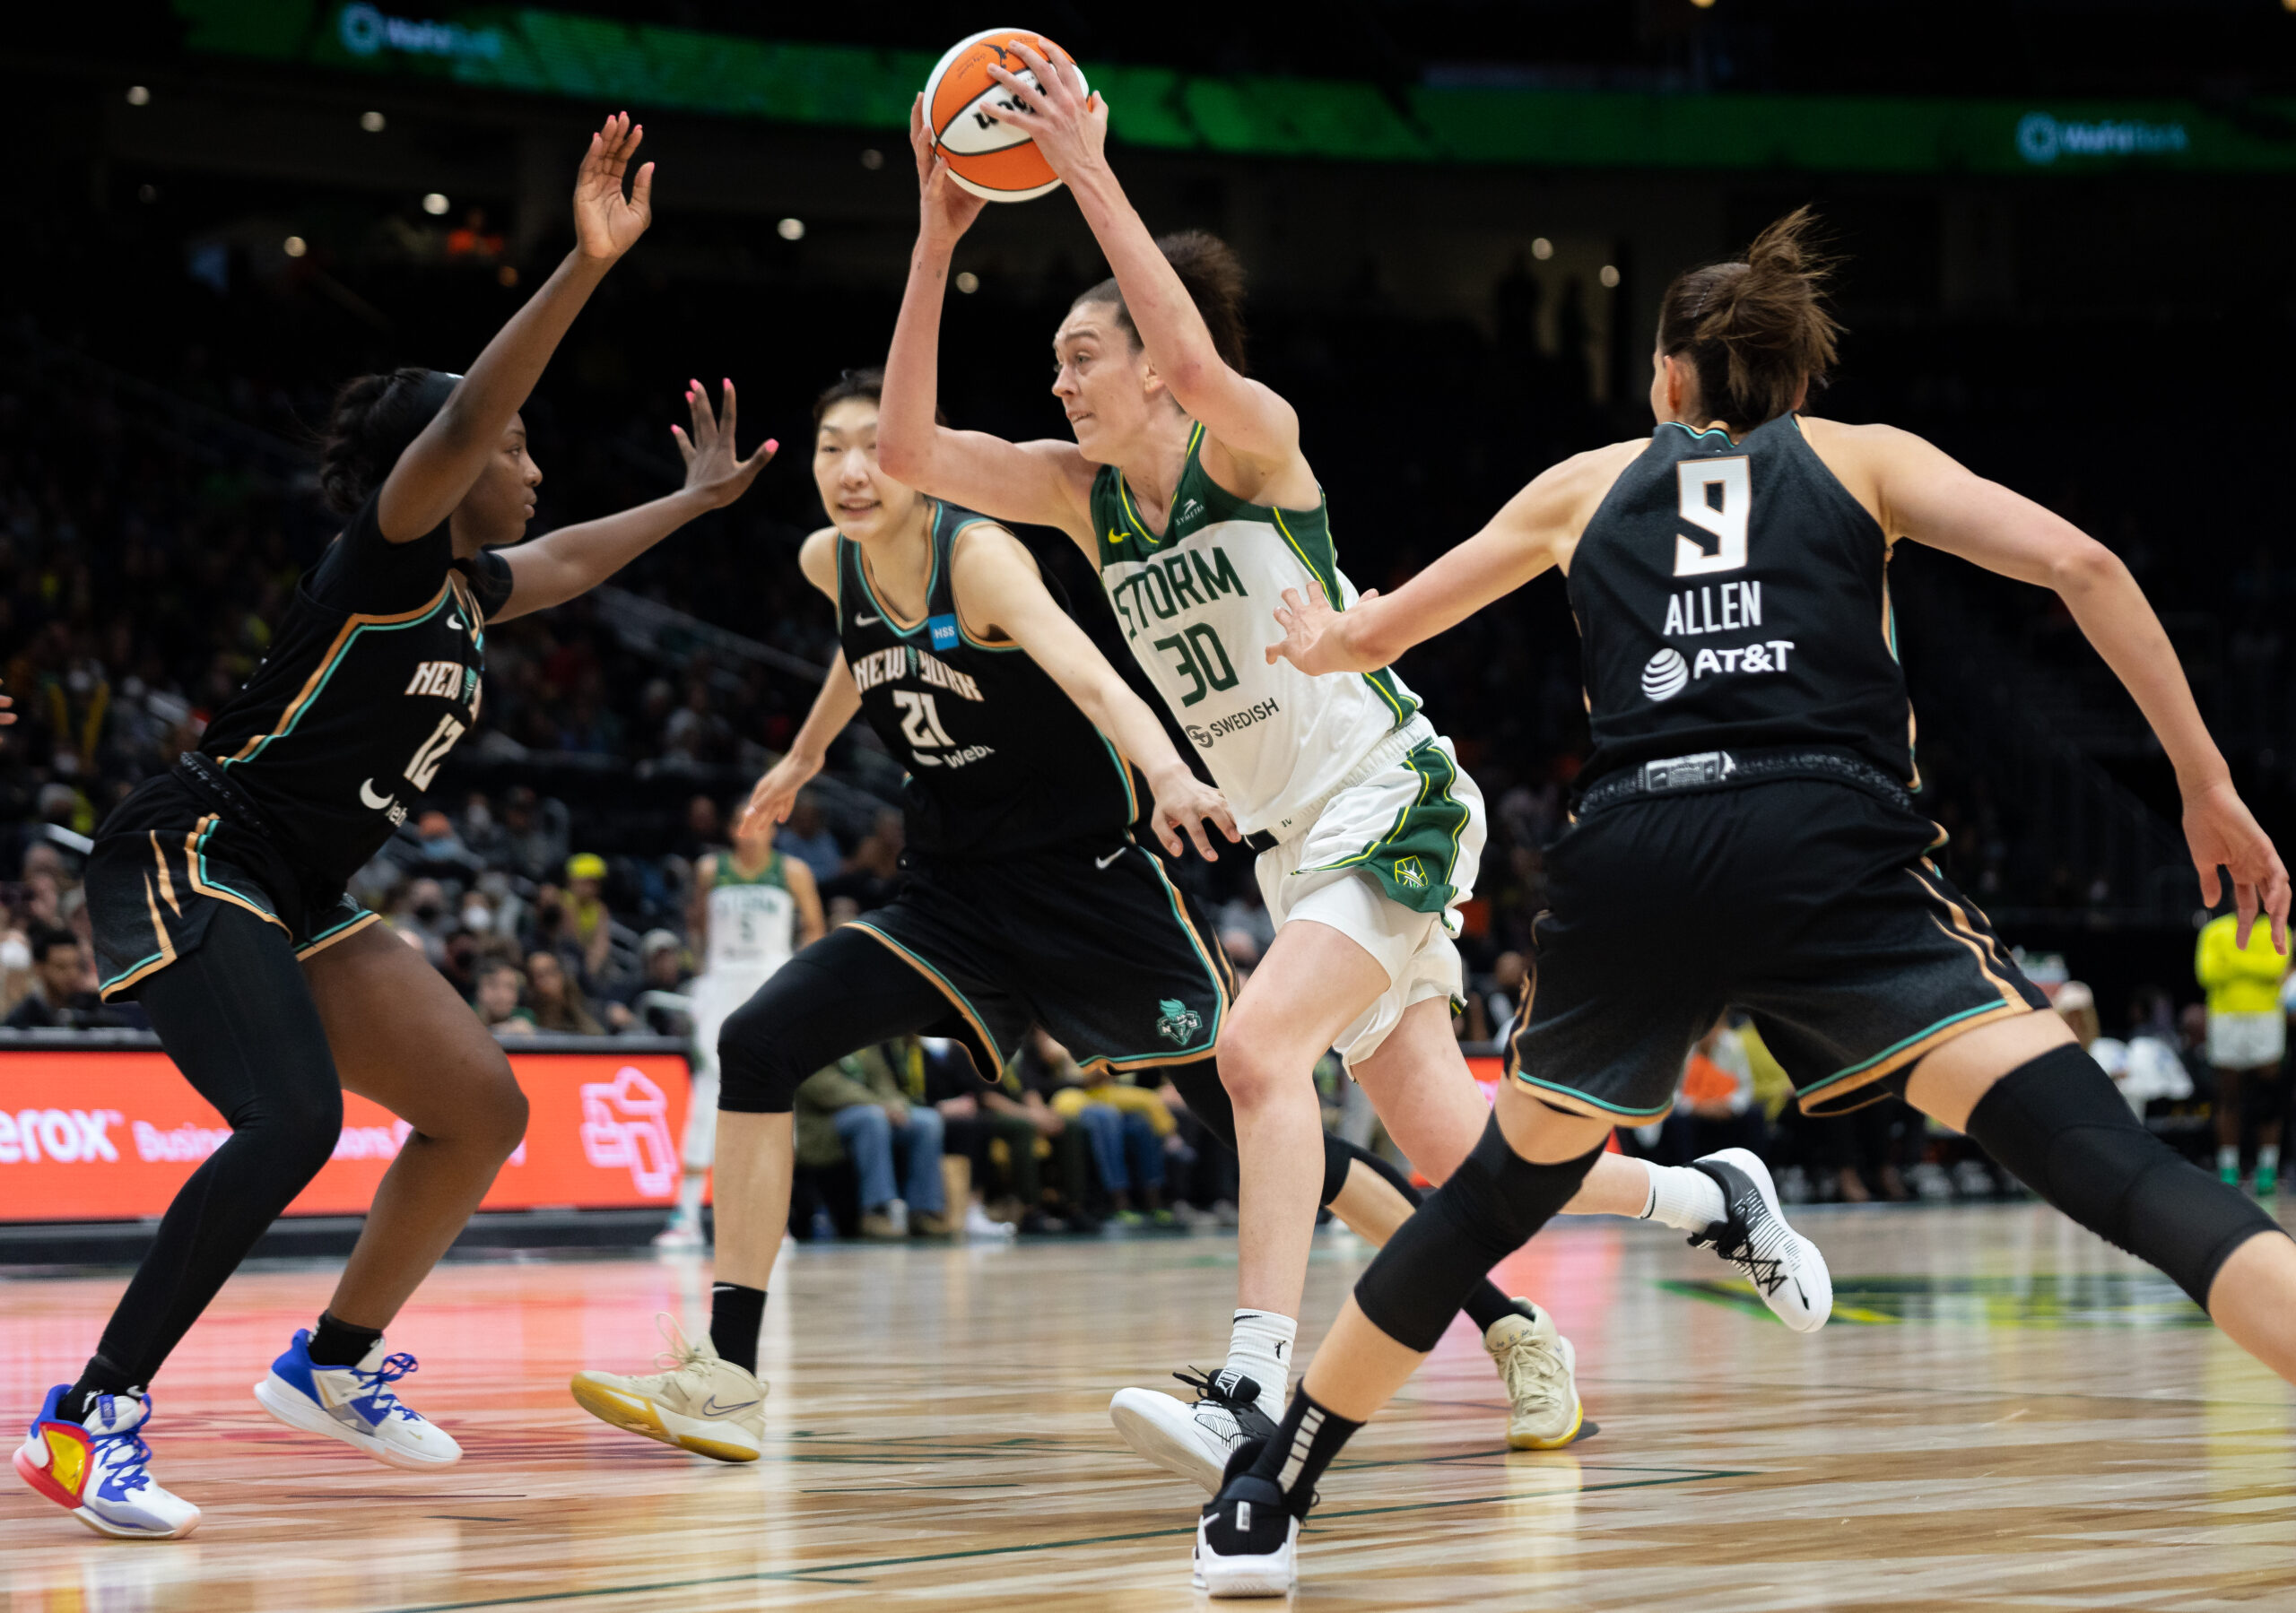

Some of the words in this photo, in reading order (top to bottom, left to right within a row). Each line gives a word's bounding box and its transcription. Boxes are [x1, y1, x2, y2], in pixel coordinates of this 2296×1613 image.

[1673, 455, 1751, 577] 9
[1112, 546, 1248, 641] STORM
[1663, 580, 1761, 636] ALLEN
[934, 625, 955, 638] HSS
[1693, 640, 1795, 680] AT&T
[853, 646, 906, 695] NEW
[918, 648, 985, 703] YORK
[1152, 622, 1239, 707] 30
[892, 689, 956, 747] 21
[1210, 697, 1280, 738] SWEDISH
[403, 713, 466, 793] 12
